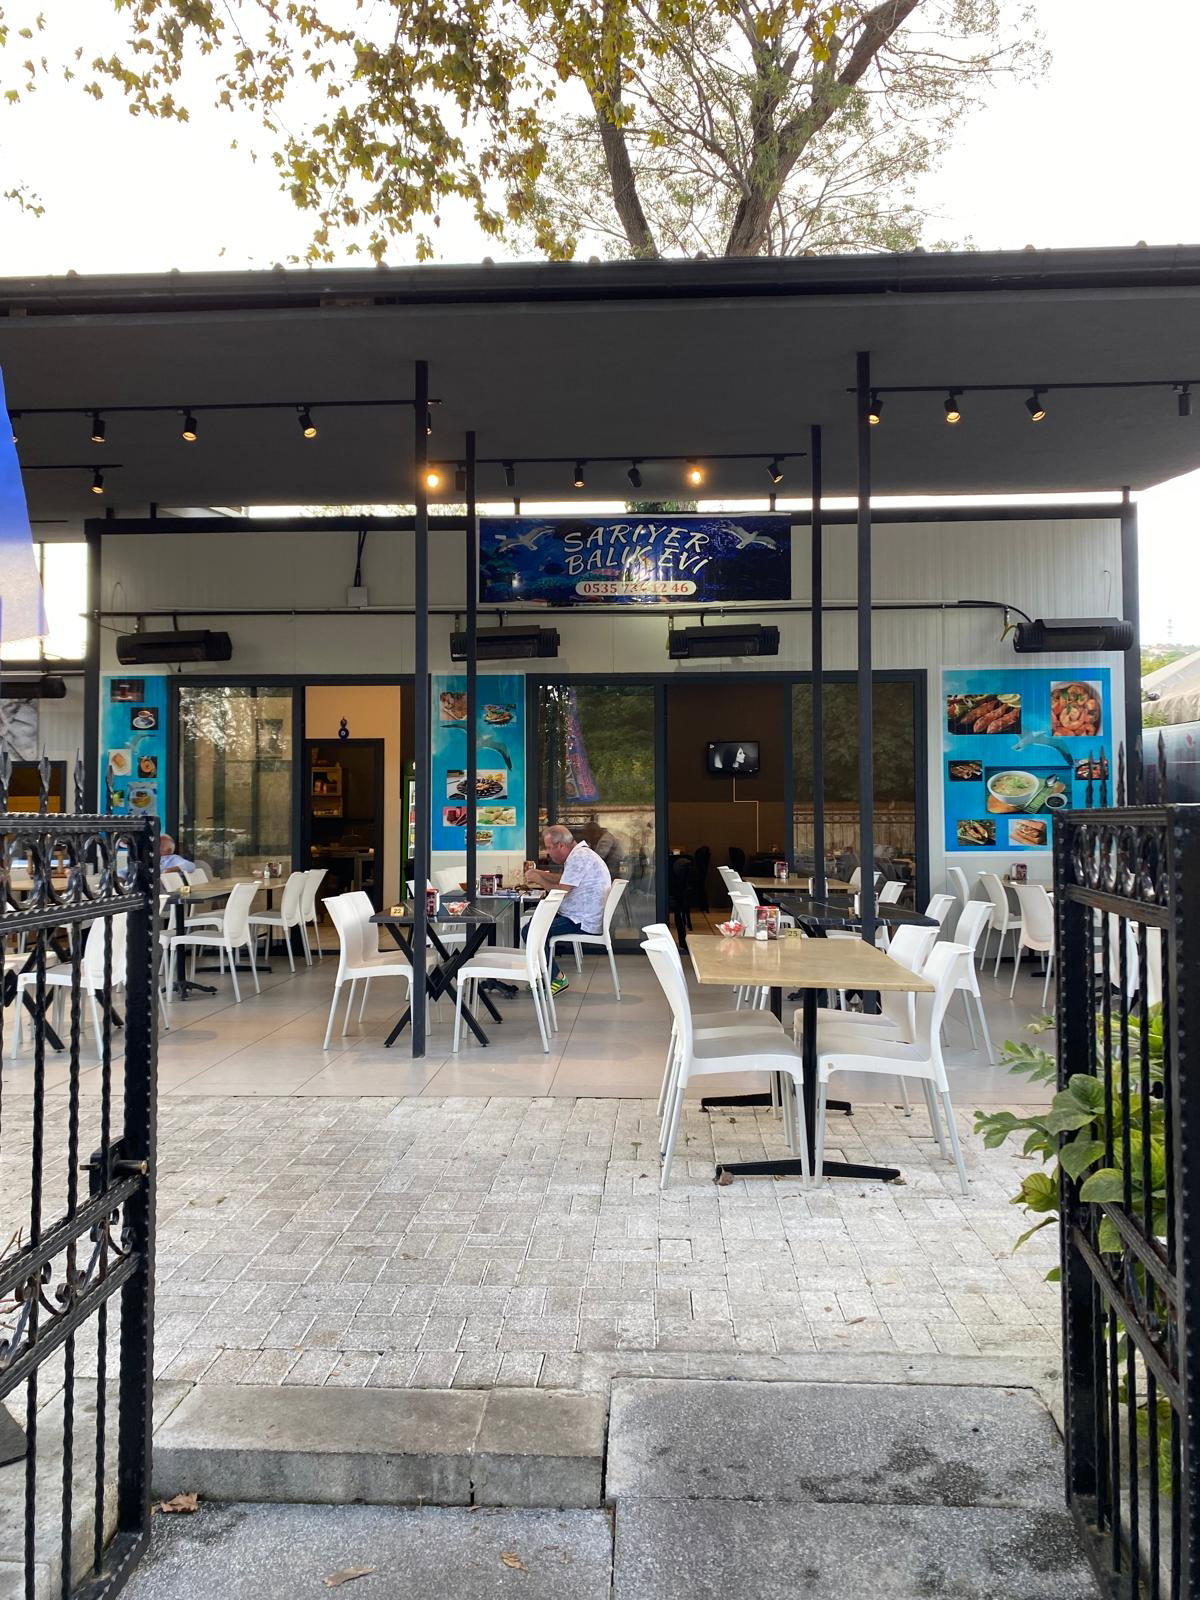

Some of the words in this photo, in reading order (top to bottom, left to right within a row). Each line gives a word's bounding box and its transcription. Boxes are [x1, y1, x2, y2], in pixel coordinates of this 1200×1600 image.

[564, 524, 710, 553] SARIYER
[565, 545, 653, 576] BALIK
[583, 583, 618, 594] 0535
[652, 583, 667, 594] 12
[671, 583, 689, 594] 46
